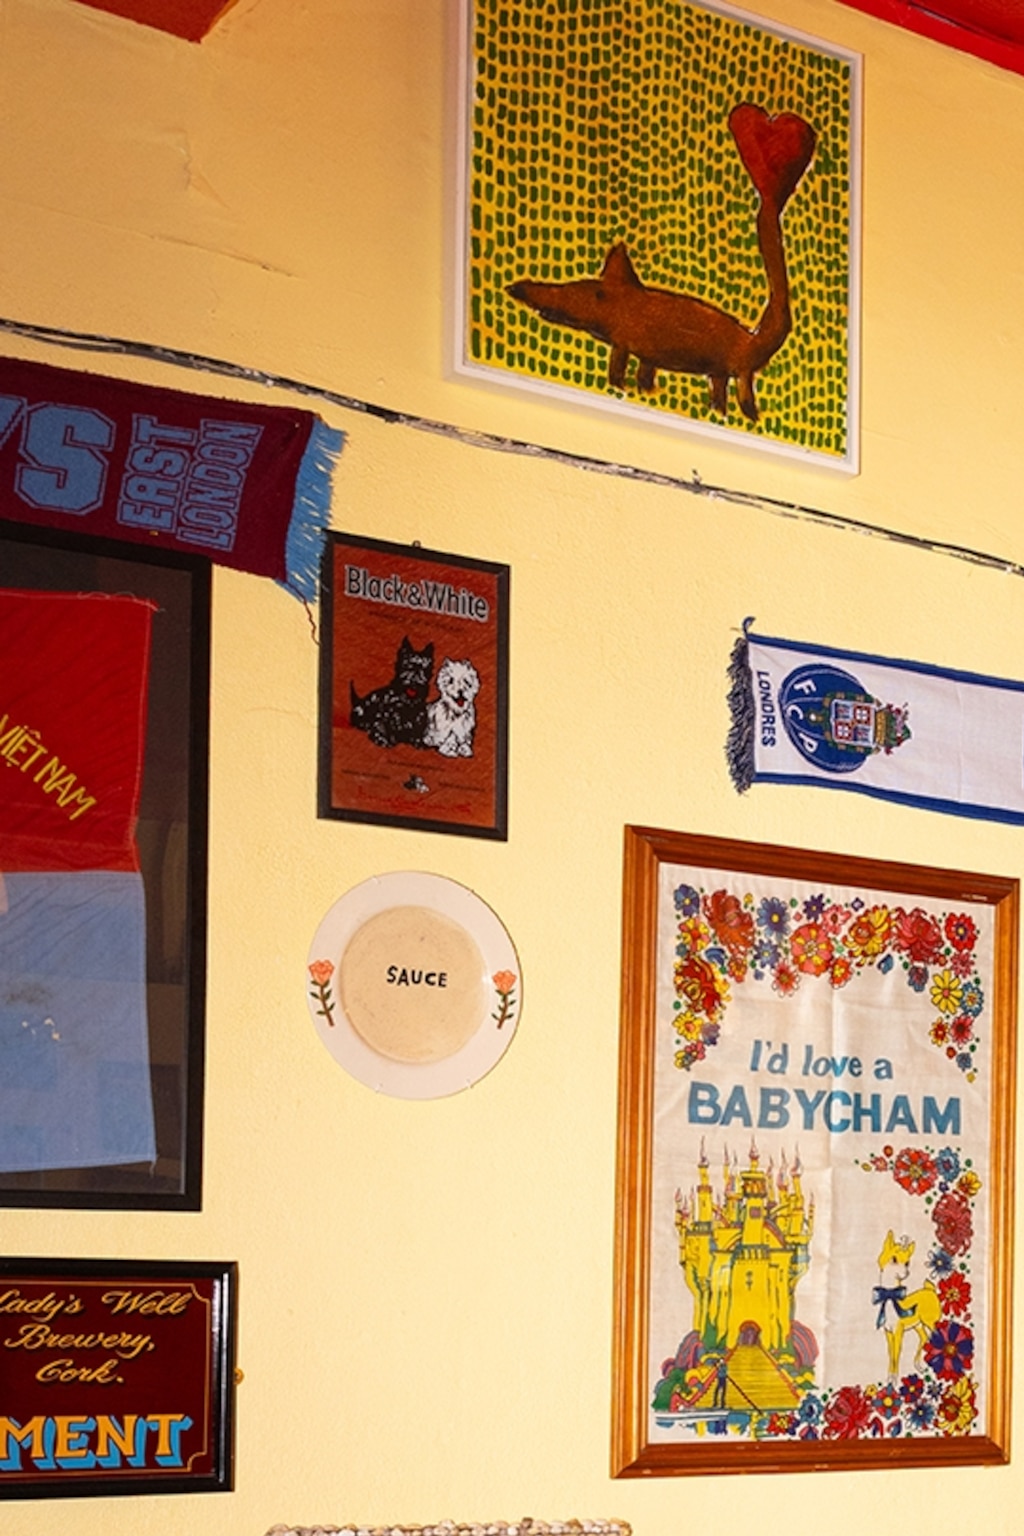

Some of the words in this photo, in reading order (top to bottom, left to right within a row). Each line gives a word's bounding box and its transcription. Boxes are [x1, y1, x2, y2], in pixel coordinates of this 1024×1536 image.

[117, 412, 200, 534] EAST
[175, 416, 265, 552] LONDON
[756, 669, 777, 748] LONDRES
[33, 755, 97, 821] NAM
[386, 964, 448, 988] SAUCE
[750, 1039, 788, 1075] I'd
[801, 1044, 863, 1077] love
[873, 1058, 894, 1081] a
[687, 1081, 961, 1136] BABYCHAM
[101, 1290, 194, 1315] Well
[4, 1322, 156, 1359] Brewery,
